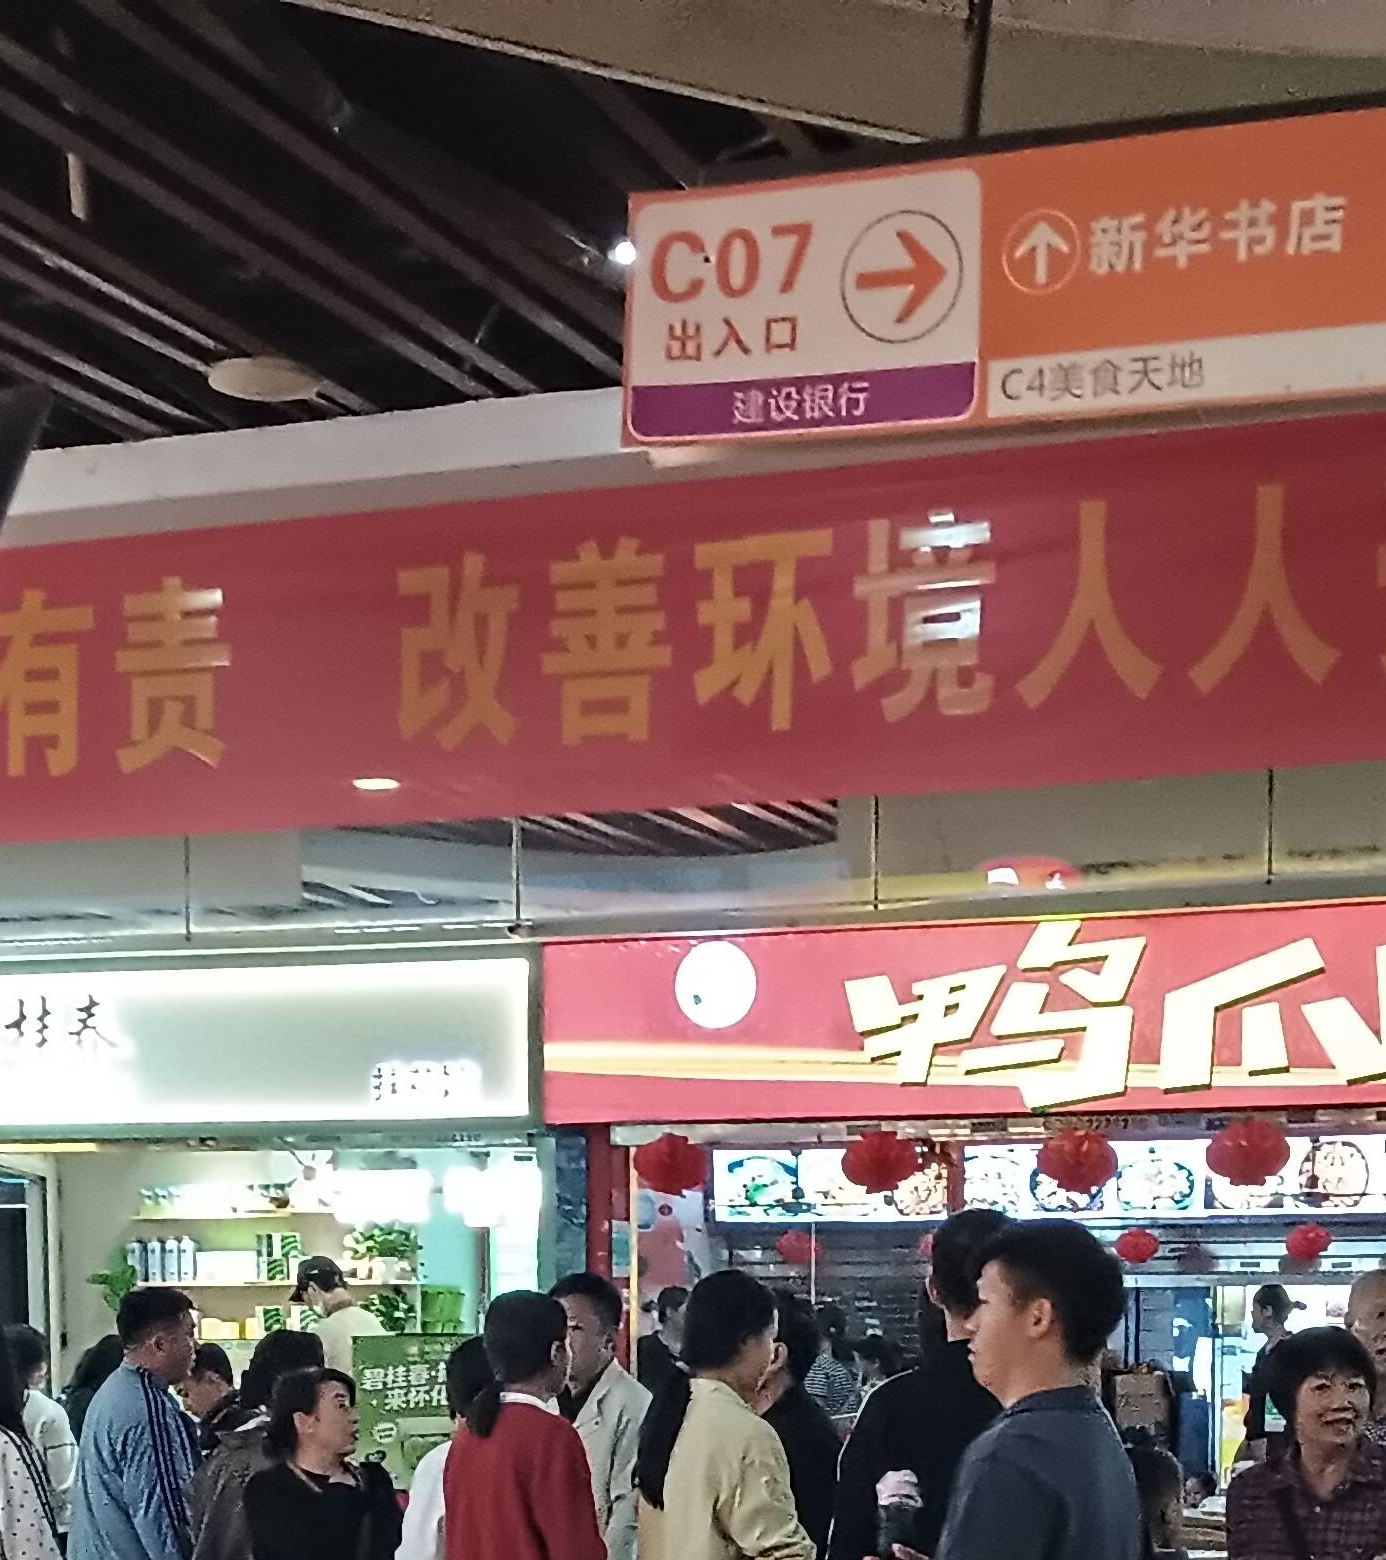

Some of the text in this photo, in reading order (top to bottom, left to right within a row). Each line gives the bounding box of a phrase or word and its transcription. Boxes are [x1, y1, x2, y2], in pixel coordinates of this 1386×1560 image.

[1088, 193, 1347, 275] 新华书店
[650, 223, 814, 304] C07
[664, 316, 799, 362] 出入口
[1000, 351, 1205, 401] C4美食天地
[732, 381, 870, 425] 建设银行
